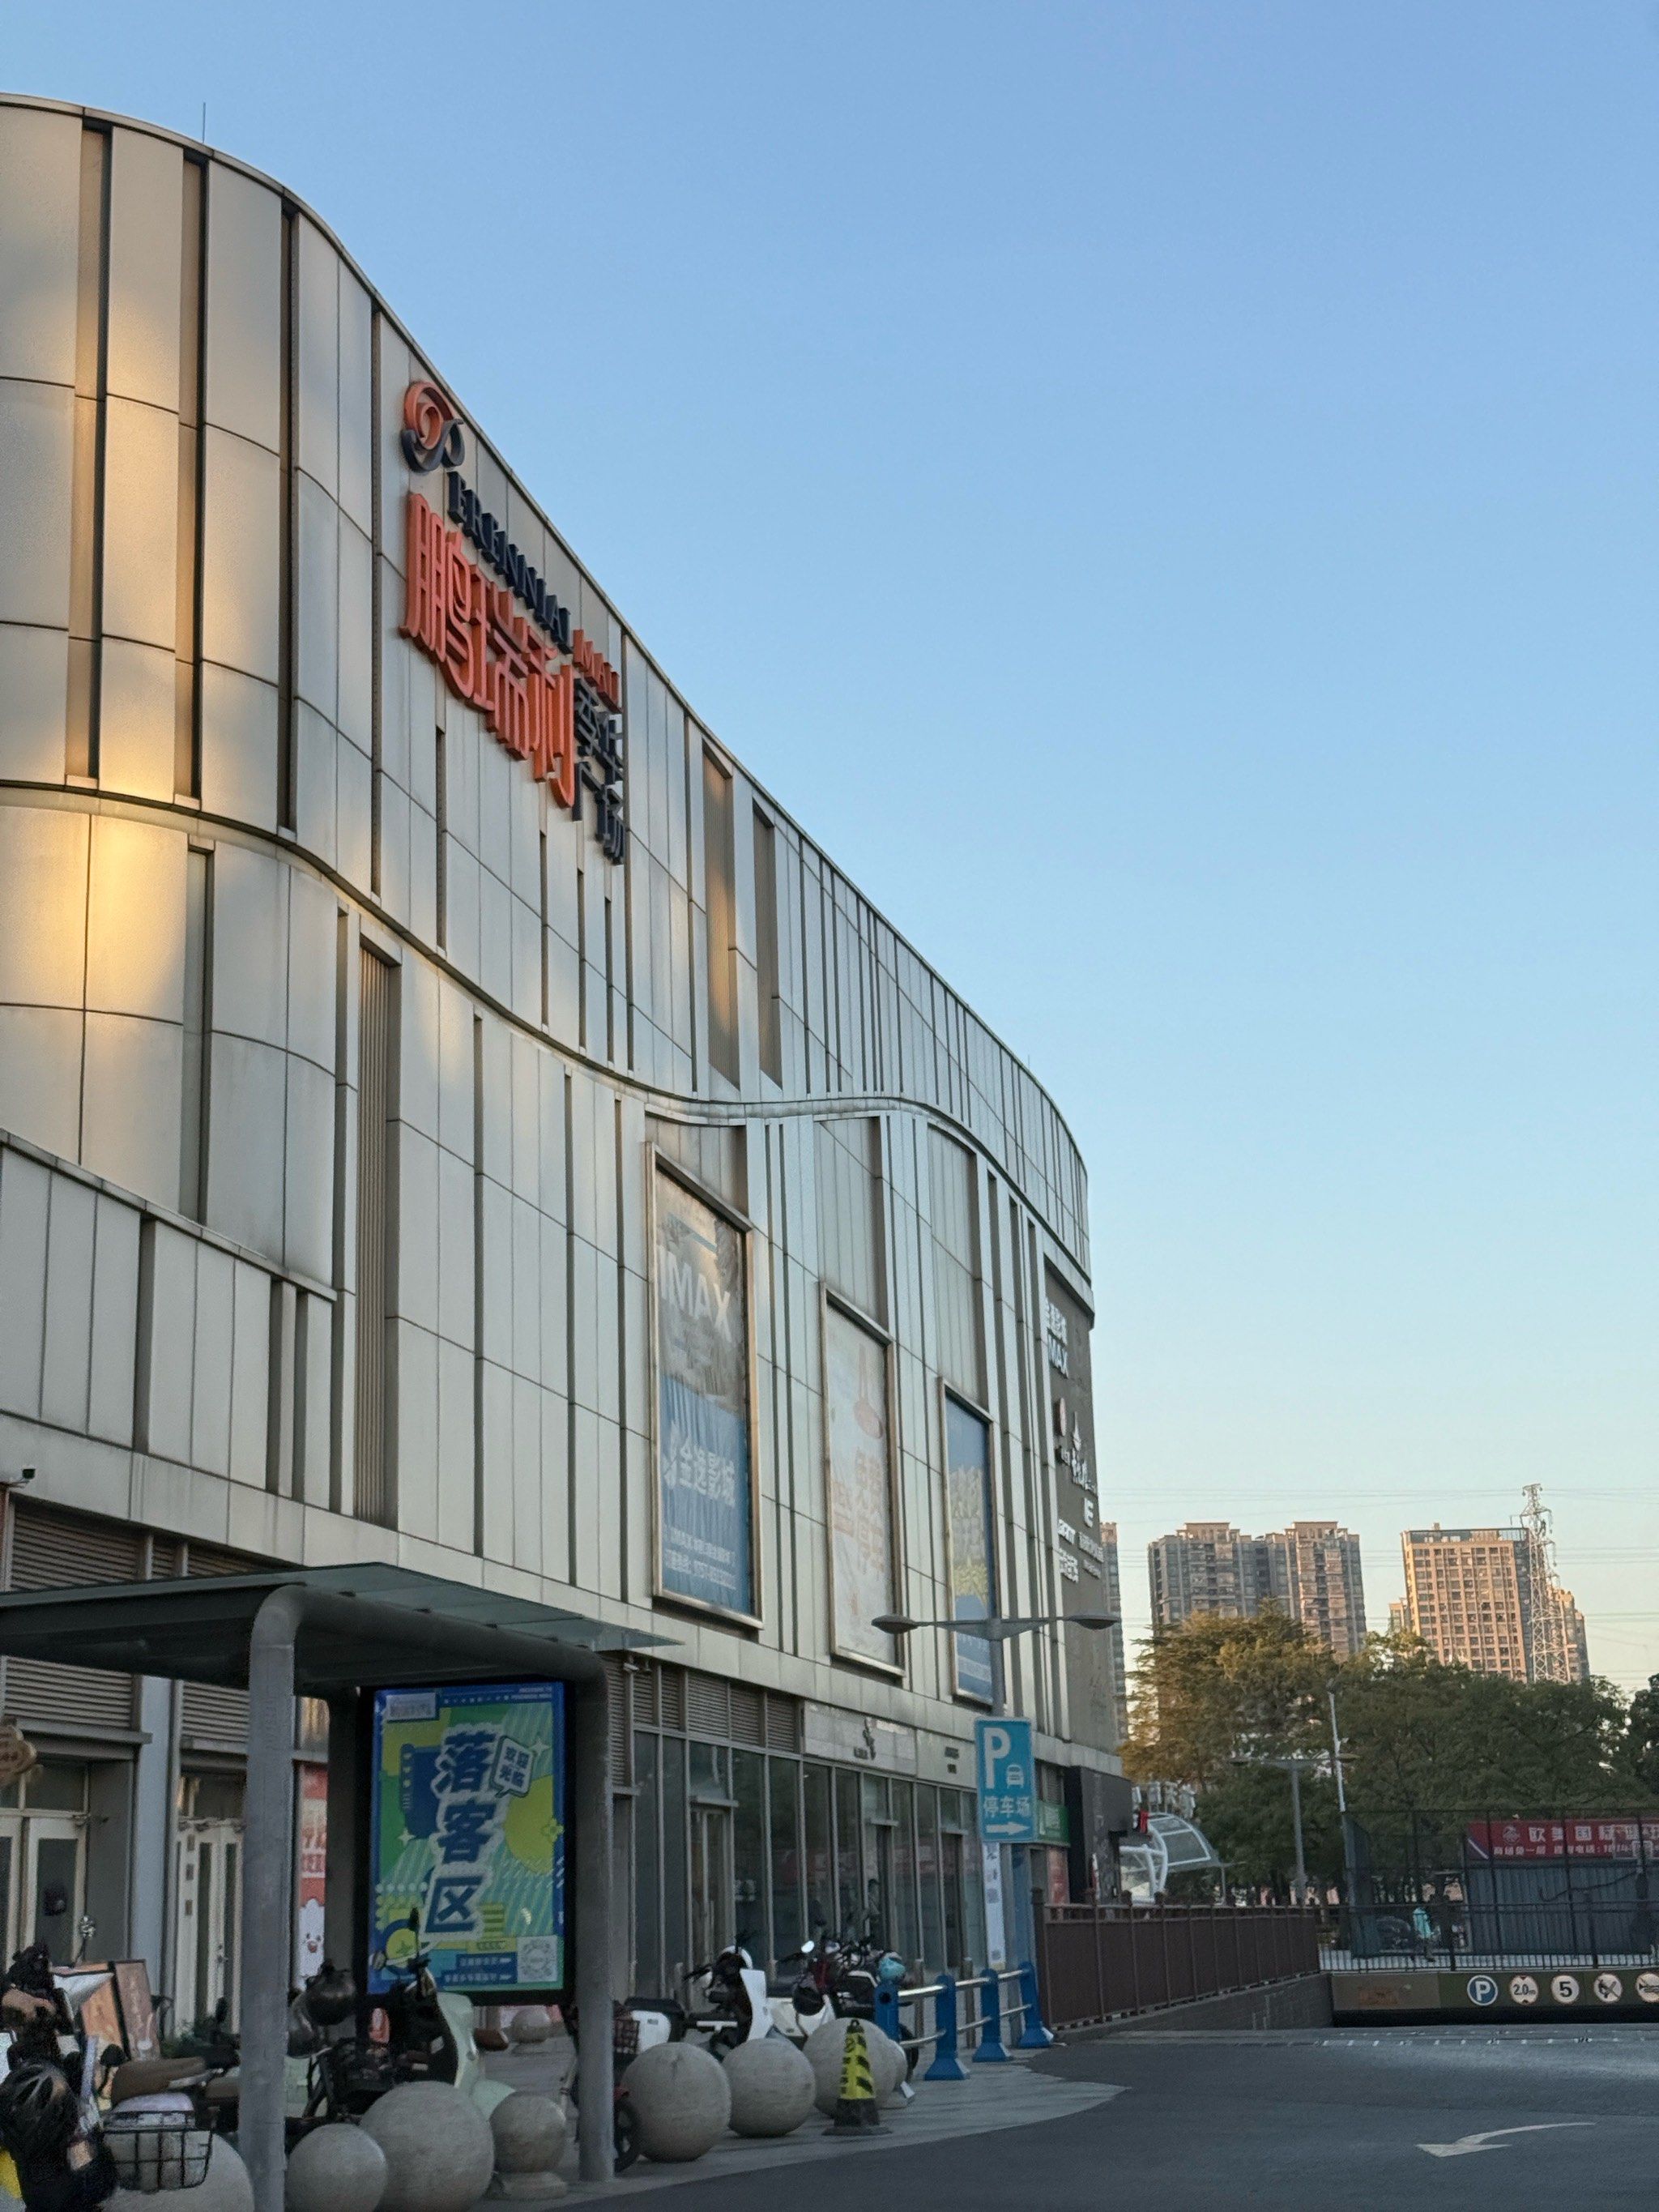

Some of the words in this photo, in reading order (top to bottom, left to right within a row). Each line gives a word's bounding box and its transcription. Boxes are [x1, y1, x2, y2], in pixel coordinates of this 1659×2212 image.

[399, 493, 575, 809] 鹏瑞利
[657, 1244, 732, 1343] IMAX
[983, 1727, 1011, 1790] P
[424, 1730, 500, 1934] 落客区
[983, 1796, 1031, 1819] 停车场
[1475, 1981, 1490, 2001] P
[1559, 1981, 1572, 1997] 5
